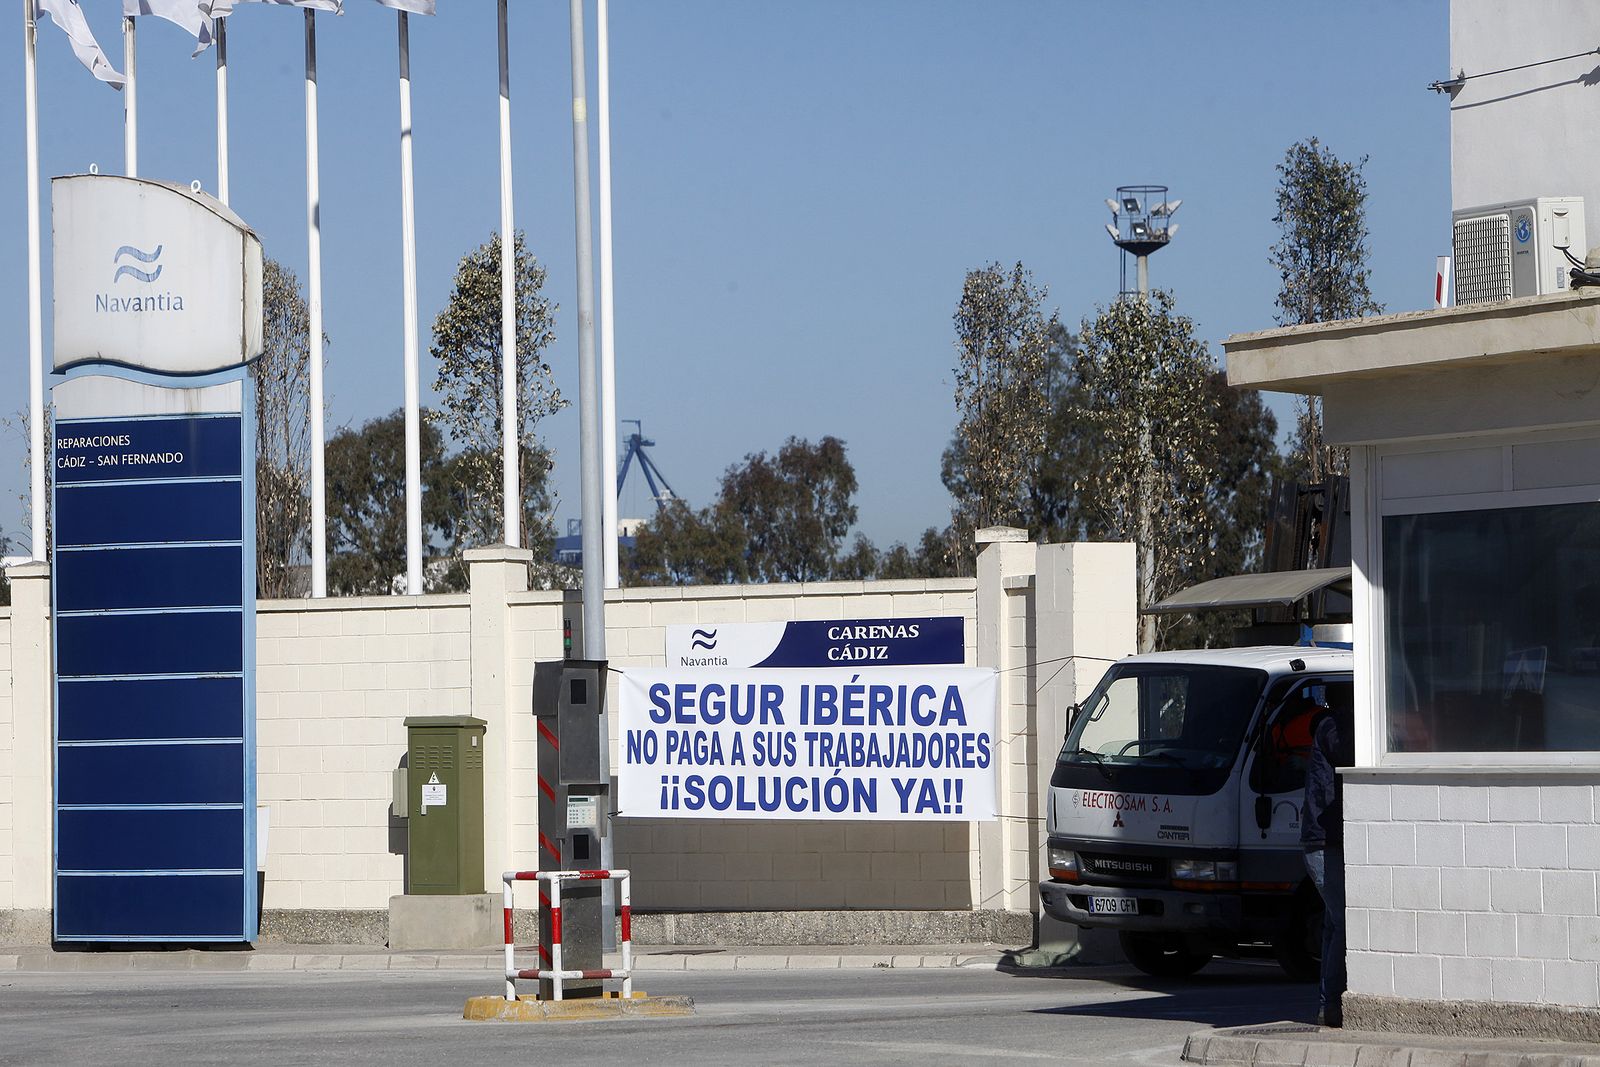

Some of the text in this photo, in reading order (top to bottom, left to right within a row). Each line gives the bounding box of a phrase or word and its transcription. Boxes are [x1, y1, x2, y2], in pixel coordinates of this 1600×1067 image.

[95, 292, 184, 312] Navantia
[57, 435, 131, 449] REPARACIONES
[57, 454, 86, 468] CÁDIZ
[97, 455, 118, 467] SAN
[122, 452, 184, 465] FERNANDO
[827, 624, 920, 640] CARENAS
[827, 643, 889, 661] CÁDIZ
[680, 655, 728, 667] Navantia
[648, 674, 967, 727] SEGUR IBÉRICA
[626, 729, 991, 769] NO PAGA A SUS TRABAJADORES
[660, 768, 963, 814] ¡¡SOLUCIÓN YA!!
[1082, 792, 1147, 812] ELECTROSAM
[1094, 859, 1153, 872] MITSUBISHI
[1095, 898, 1117, 912] 6709
